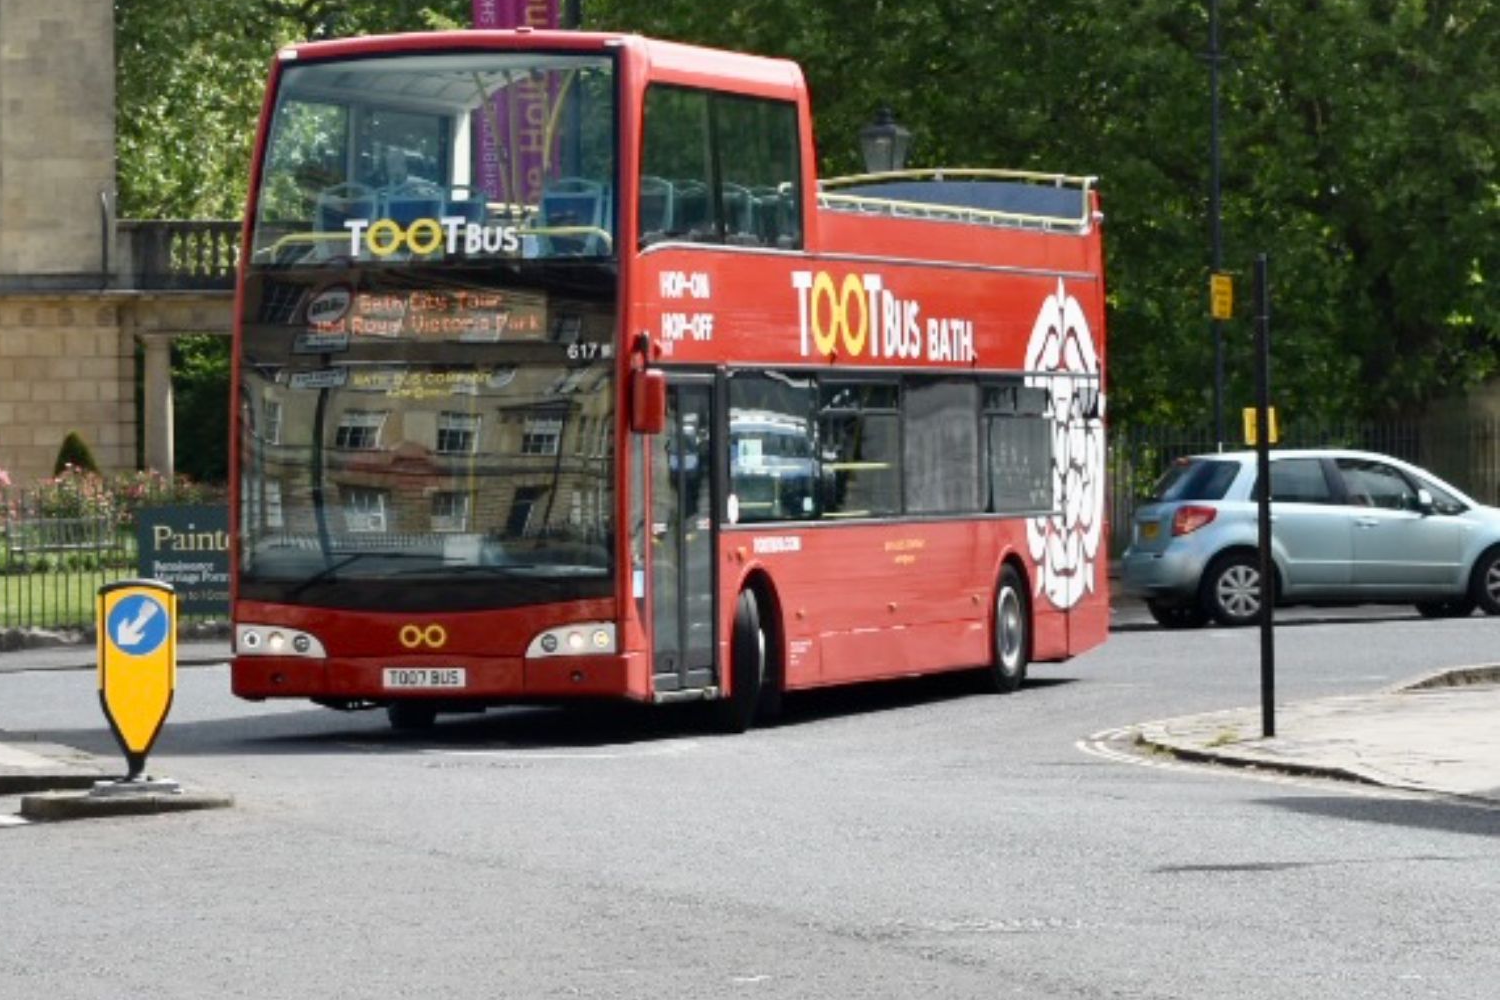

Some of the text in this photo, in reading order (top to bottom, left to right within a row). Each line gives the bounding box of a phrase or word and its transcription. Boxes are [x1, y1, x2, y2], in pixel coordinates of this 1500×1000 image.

[659, 271, 710, 299] HOP-ON
[411, 291, 448, 311] City
[496, 313, 540, 331] Park
[661, 312, 714, 341] HOP-OFF
[926, 317, 973, 361] BATH
[566, 343, 598, 359] 617
[430, 670, 459, 684] BUS
